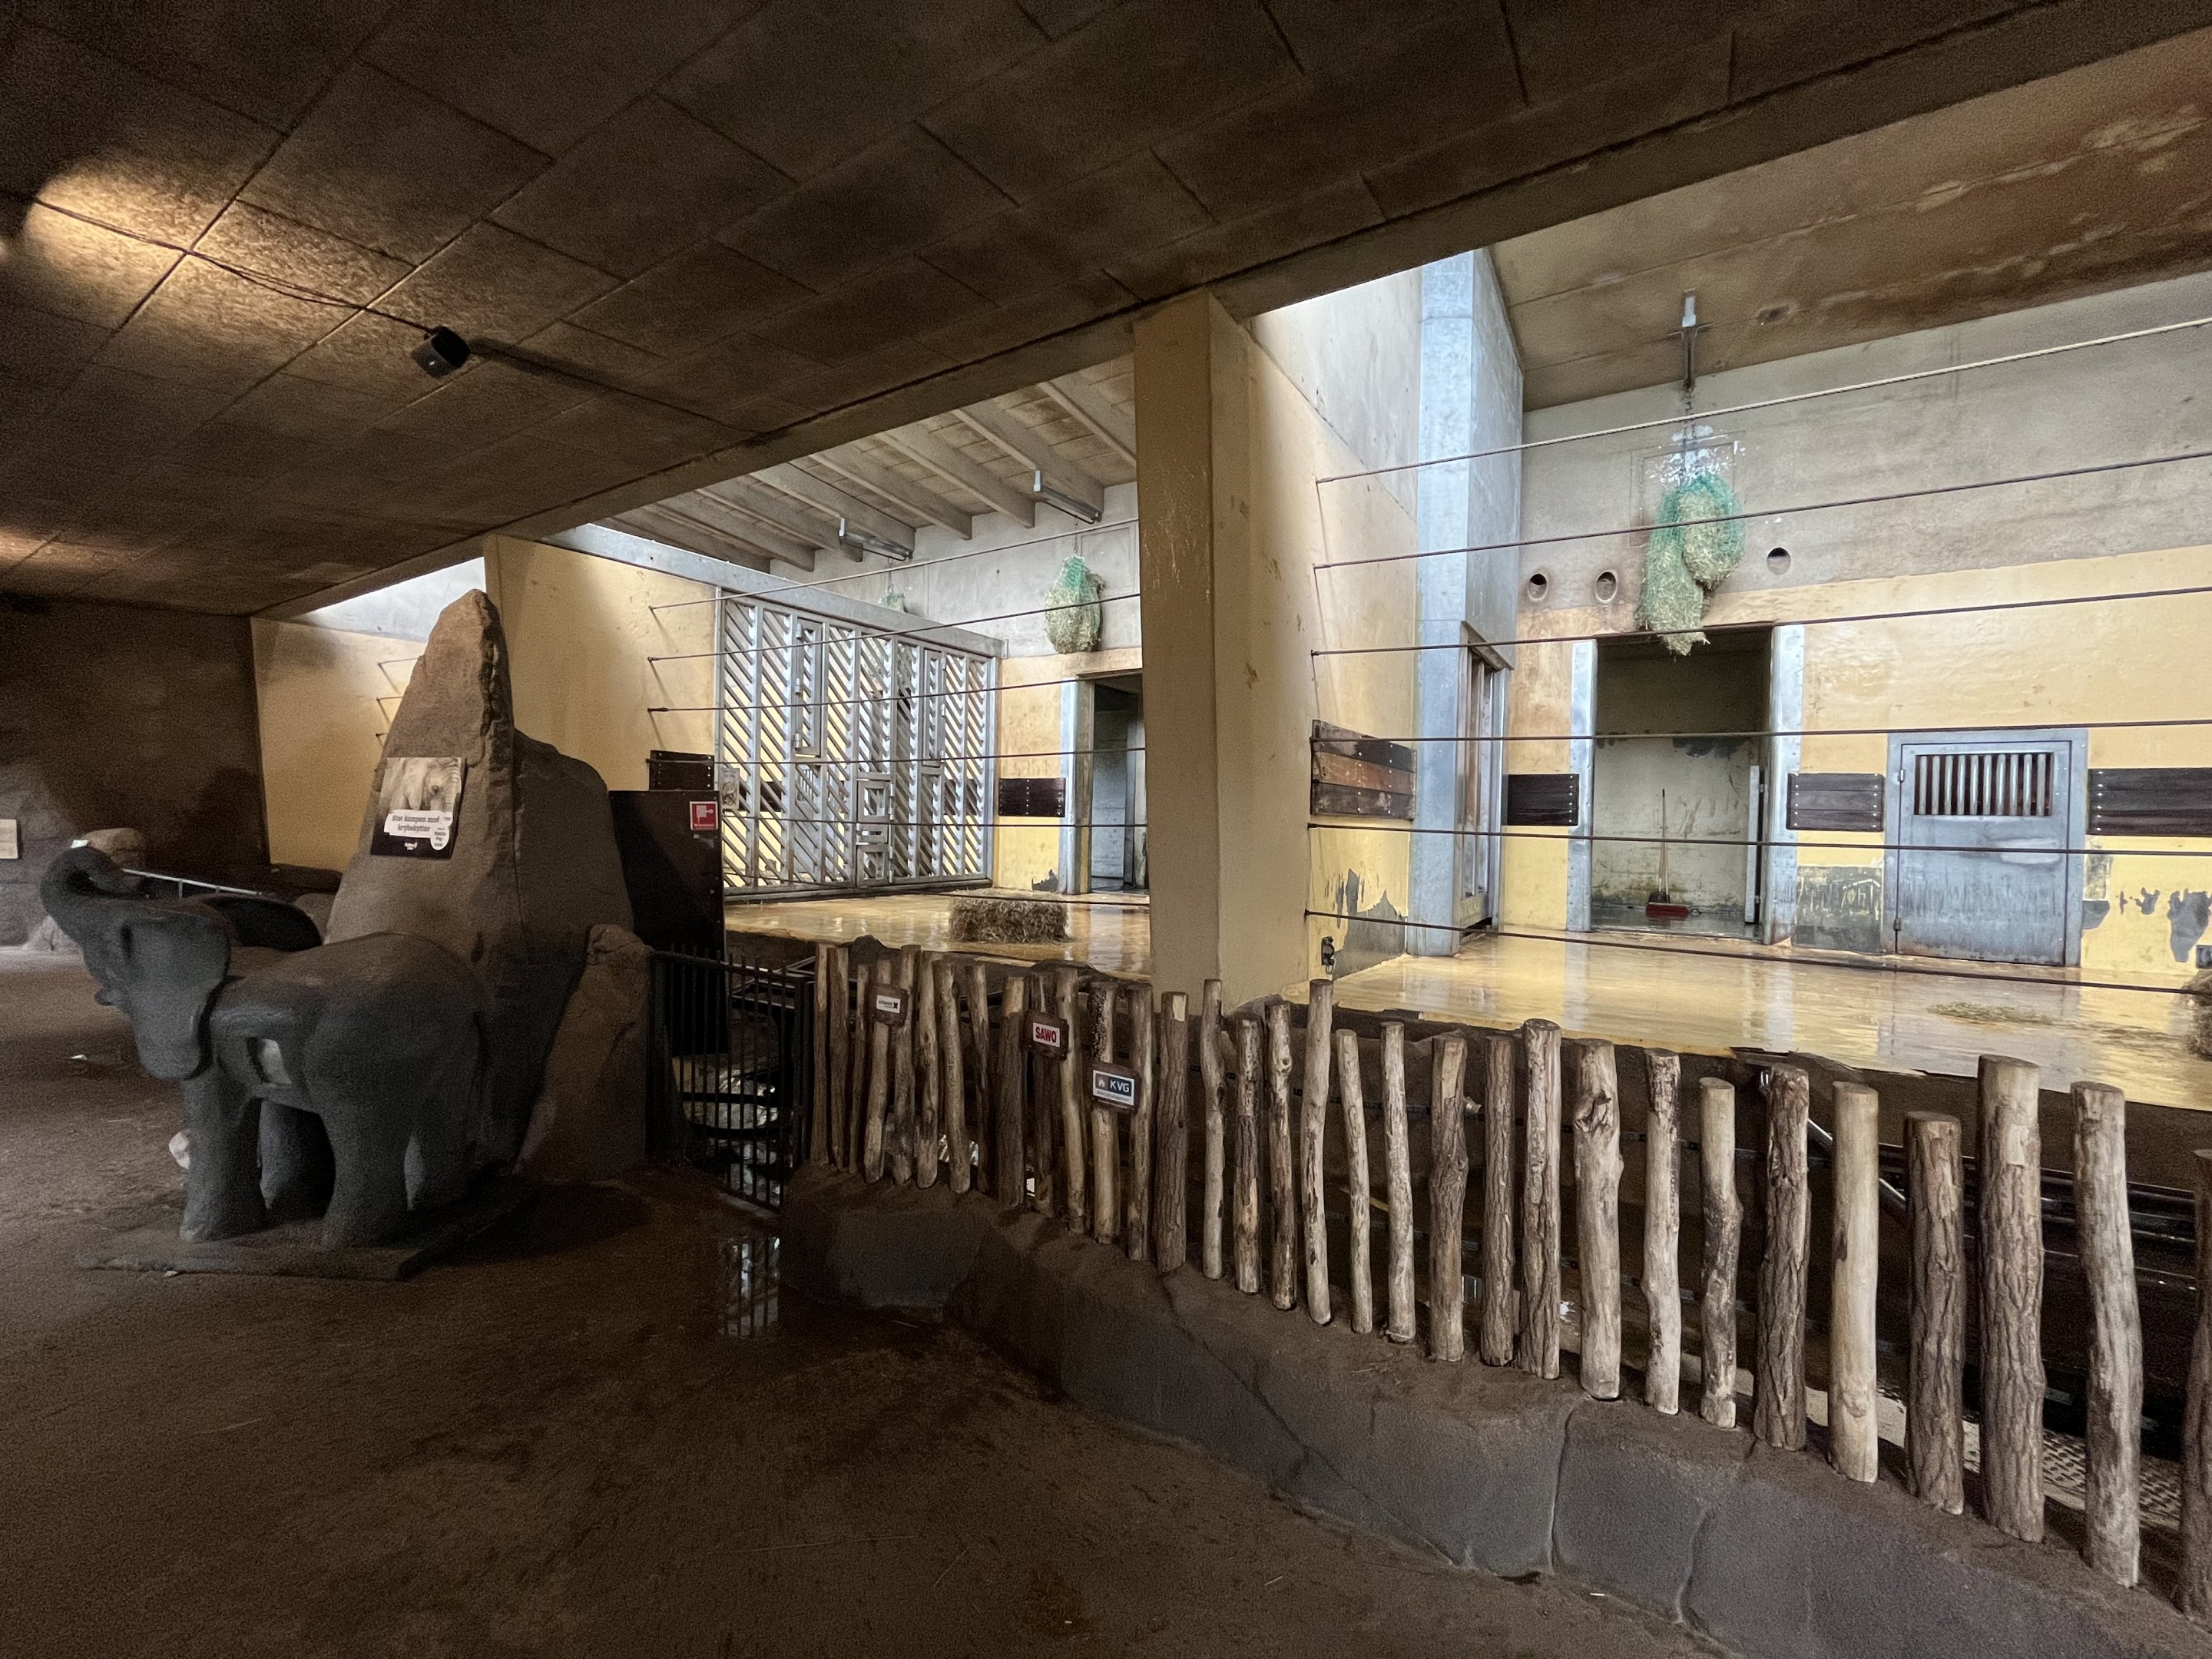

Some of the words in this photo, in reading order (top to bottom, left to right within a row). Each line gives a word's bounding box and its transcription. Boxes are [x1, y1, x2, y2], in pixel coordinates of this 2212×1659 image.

[404, 815, 426, 823] kampen
[1035, 1026, 1057, 1043] SAWO
[1110, 1079, 1130, 1092] KVG
